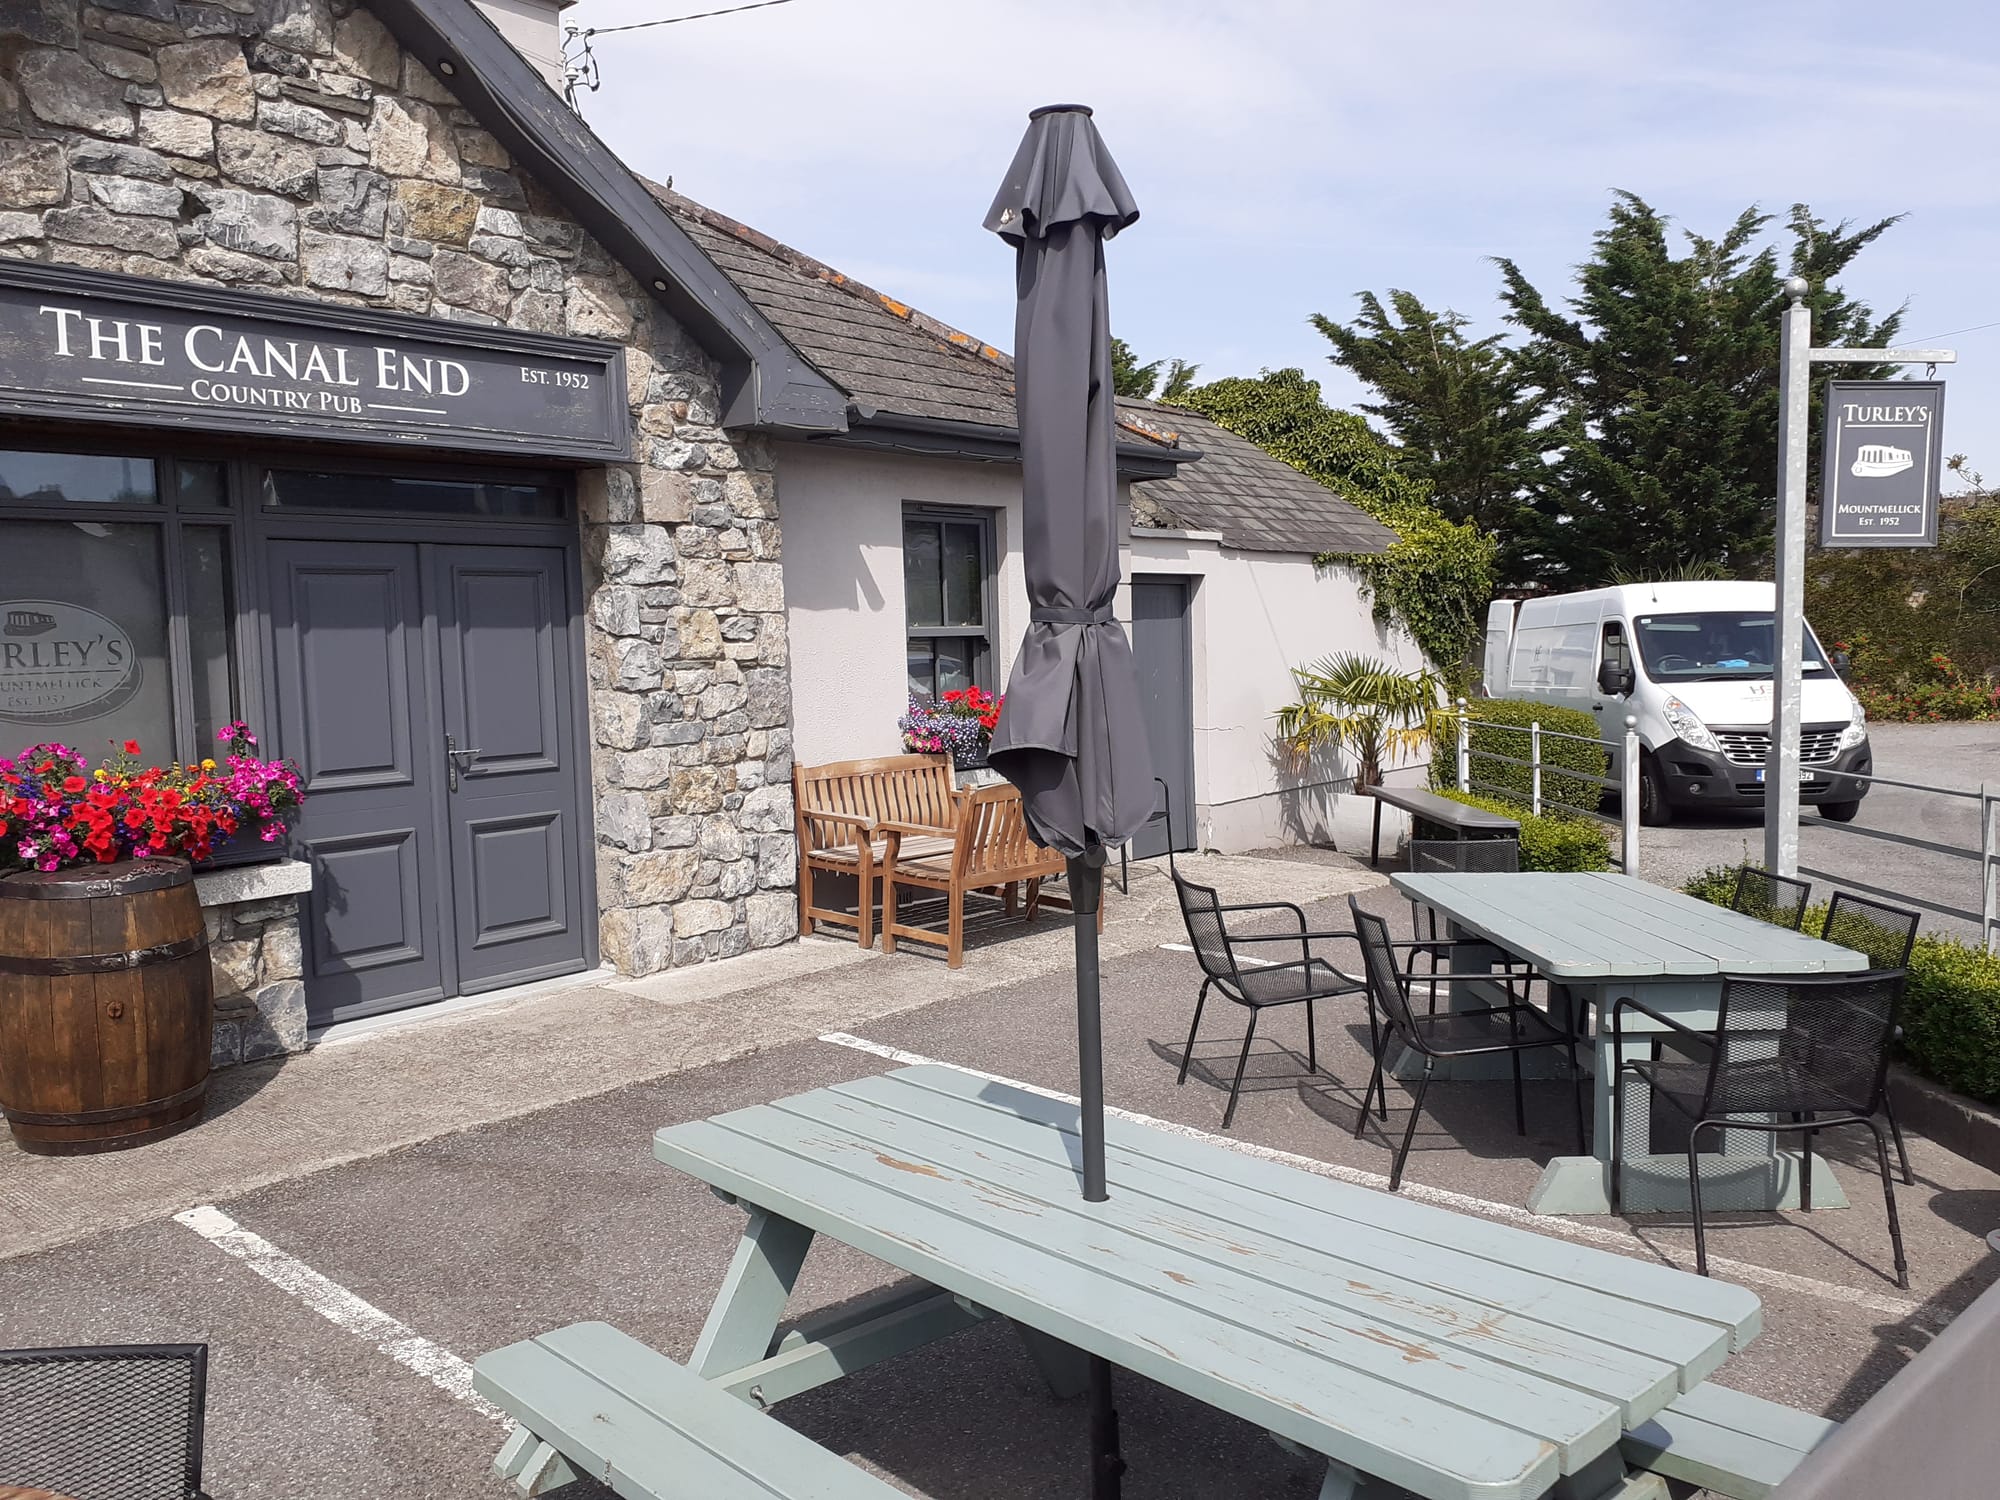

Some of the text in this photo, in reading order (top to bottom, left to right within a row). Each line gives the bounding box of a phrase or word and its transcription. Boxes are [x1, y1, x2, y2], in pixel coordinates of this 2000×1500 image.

[40, 305, 470, 396] THE CANAL END
[520, 366, 590, 389] EST. 1952
[191, 379, 363, 414] COUNTRY PUB
[1843, 403, 1928, 422] TURLEY'S
[1837, 503, 1921, 514] MOUNTMELLICK
[1879, 517, 1900, 526] 1952
